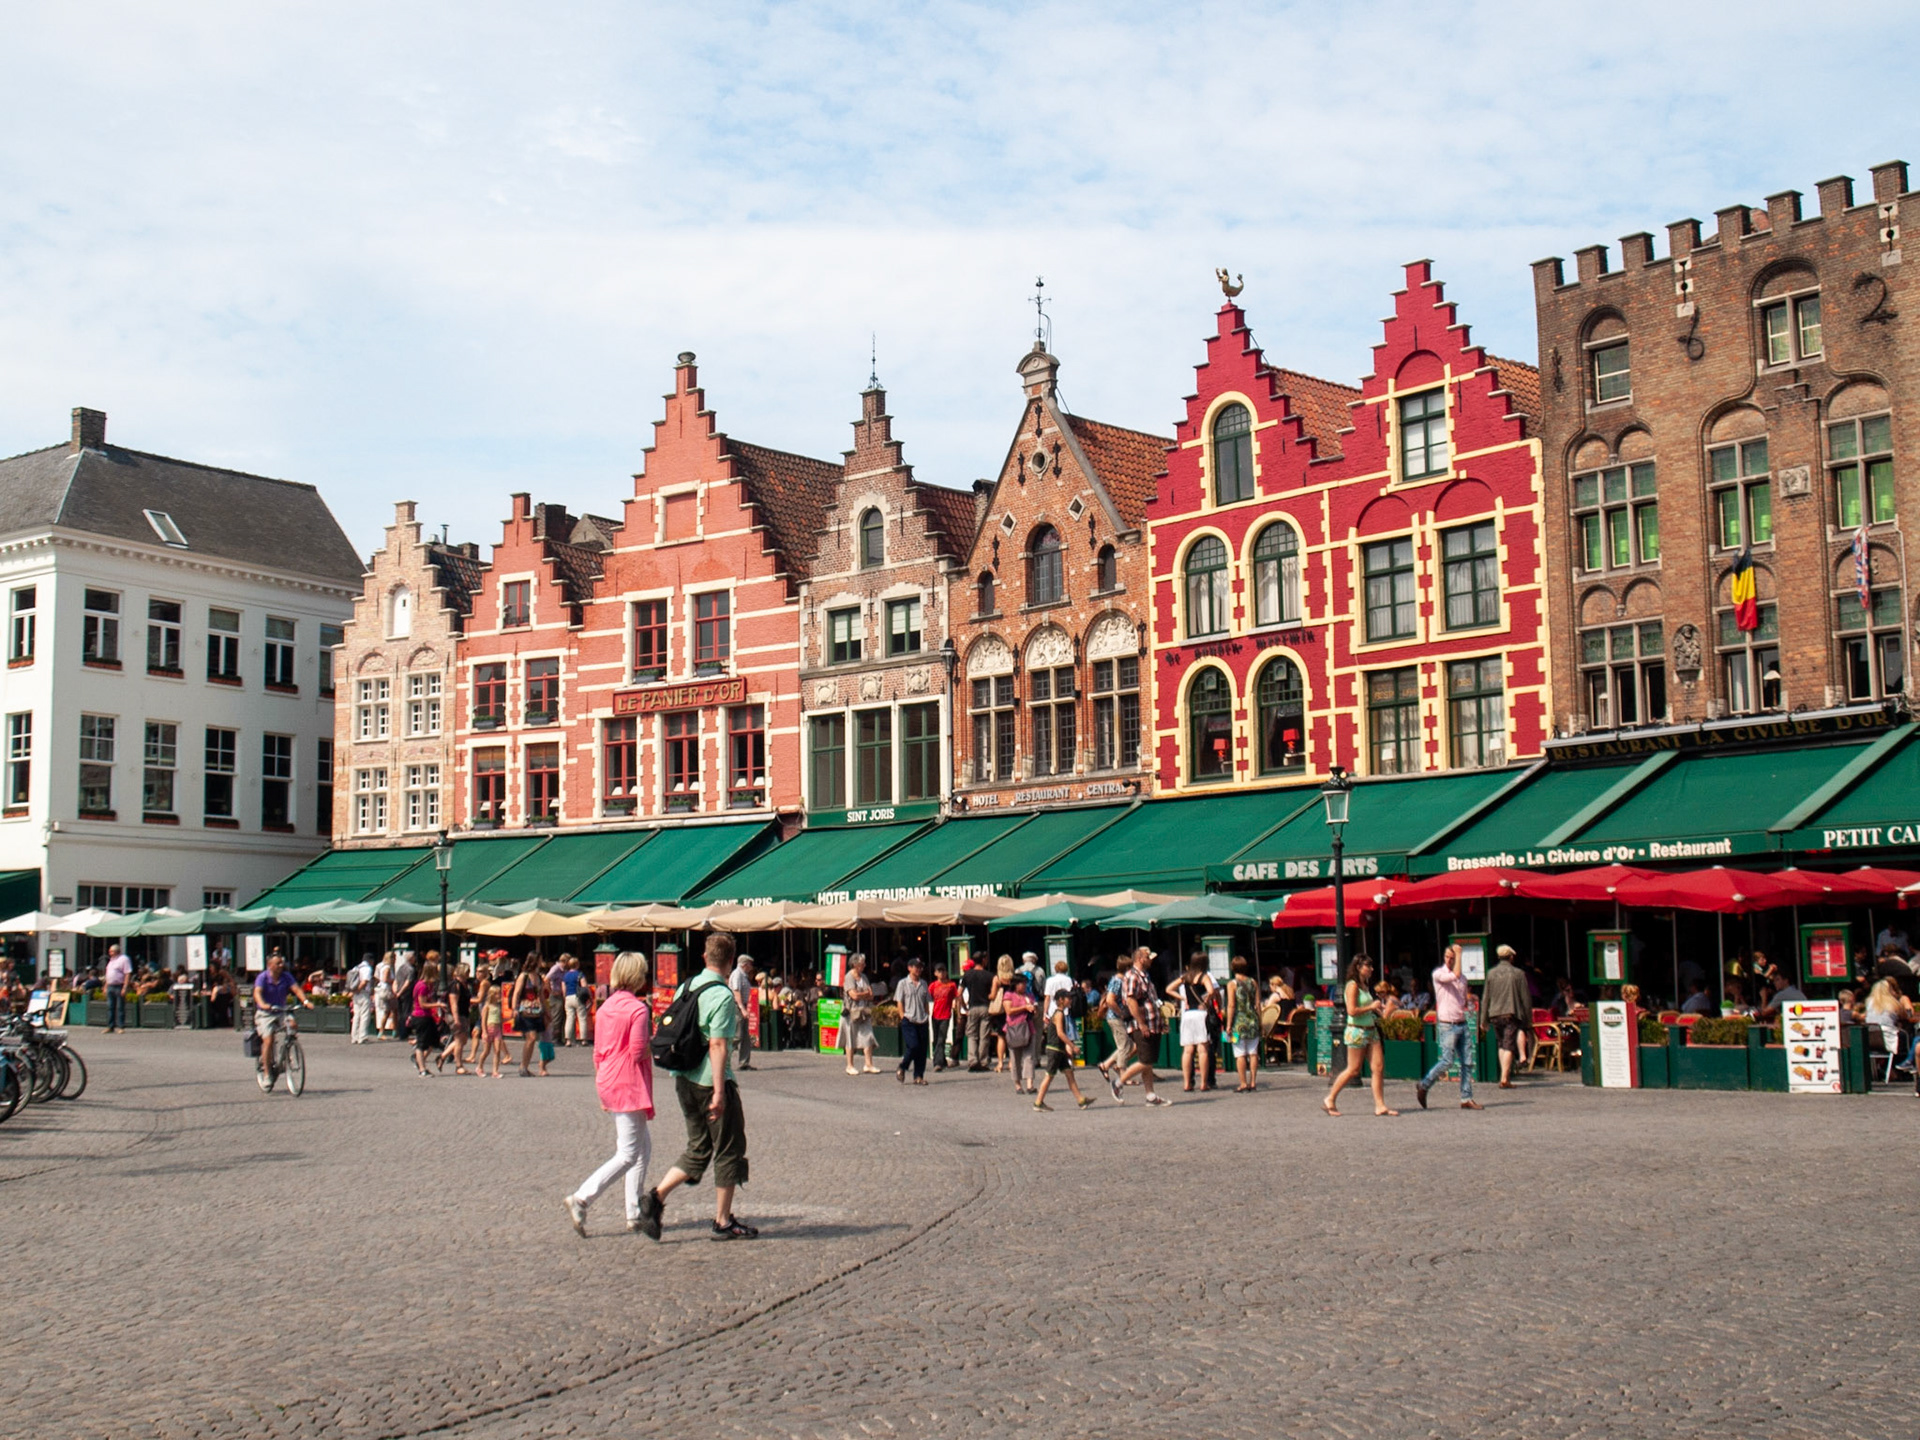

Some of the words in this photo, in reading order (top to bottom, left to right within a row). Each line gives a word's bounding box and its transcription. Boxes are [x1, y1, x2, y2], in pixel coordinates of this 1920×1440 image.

[618, 697, 638, 711] LE
[641, 686, 699, 709] PANIER
[1552, 734, 1682, 760] RESTAURANT
[1693, 732, 1724, 746] LA
[972, 794, 998, 807] HOTEL
[1015, 787, 1070, 802] RESTAURANT
[1086, 782, 1127, 796] CENTRAL
[847, 810, 868, 823] SINT
[869, 807, 895, 821] JORIS
[1823, 827, 1882, 848] PETIT
[1887, 825, 1920, 844] CA
[1447, 852, 1515, 871] Brasserie
[1526, 851, 1545, 865] La
[1547, 848, 1600, 864] Civiere
[1602, 845, 1636, 861] d'Or
[1650, 838, 1731, 859] Restaurant
[1232, 862, 1278, 881] CAFE
[1285, 860, 1320, 878] DES
[817, 890, 850, 906] HOTEL
[856, 886, 931, 902] RESTAURANT
